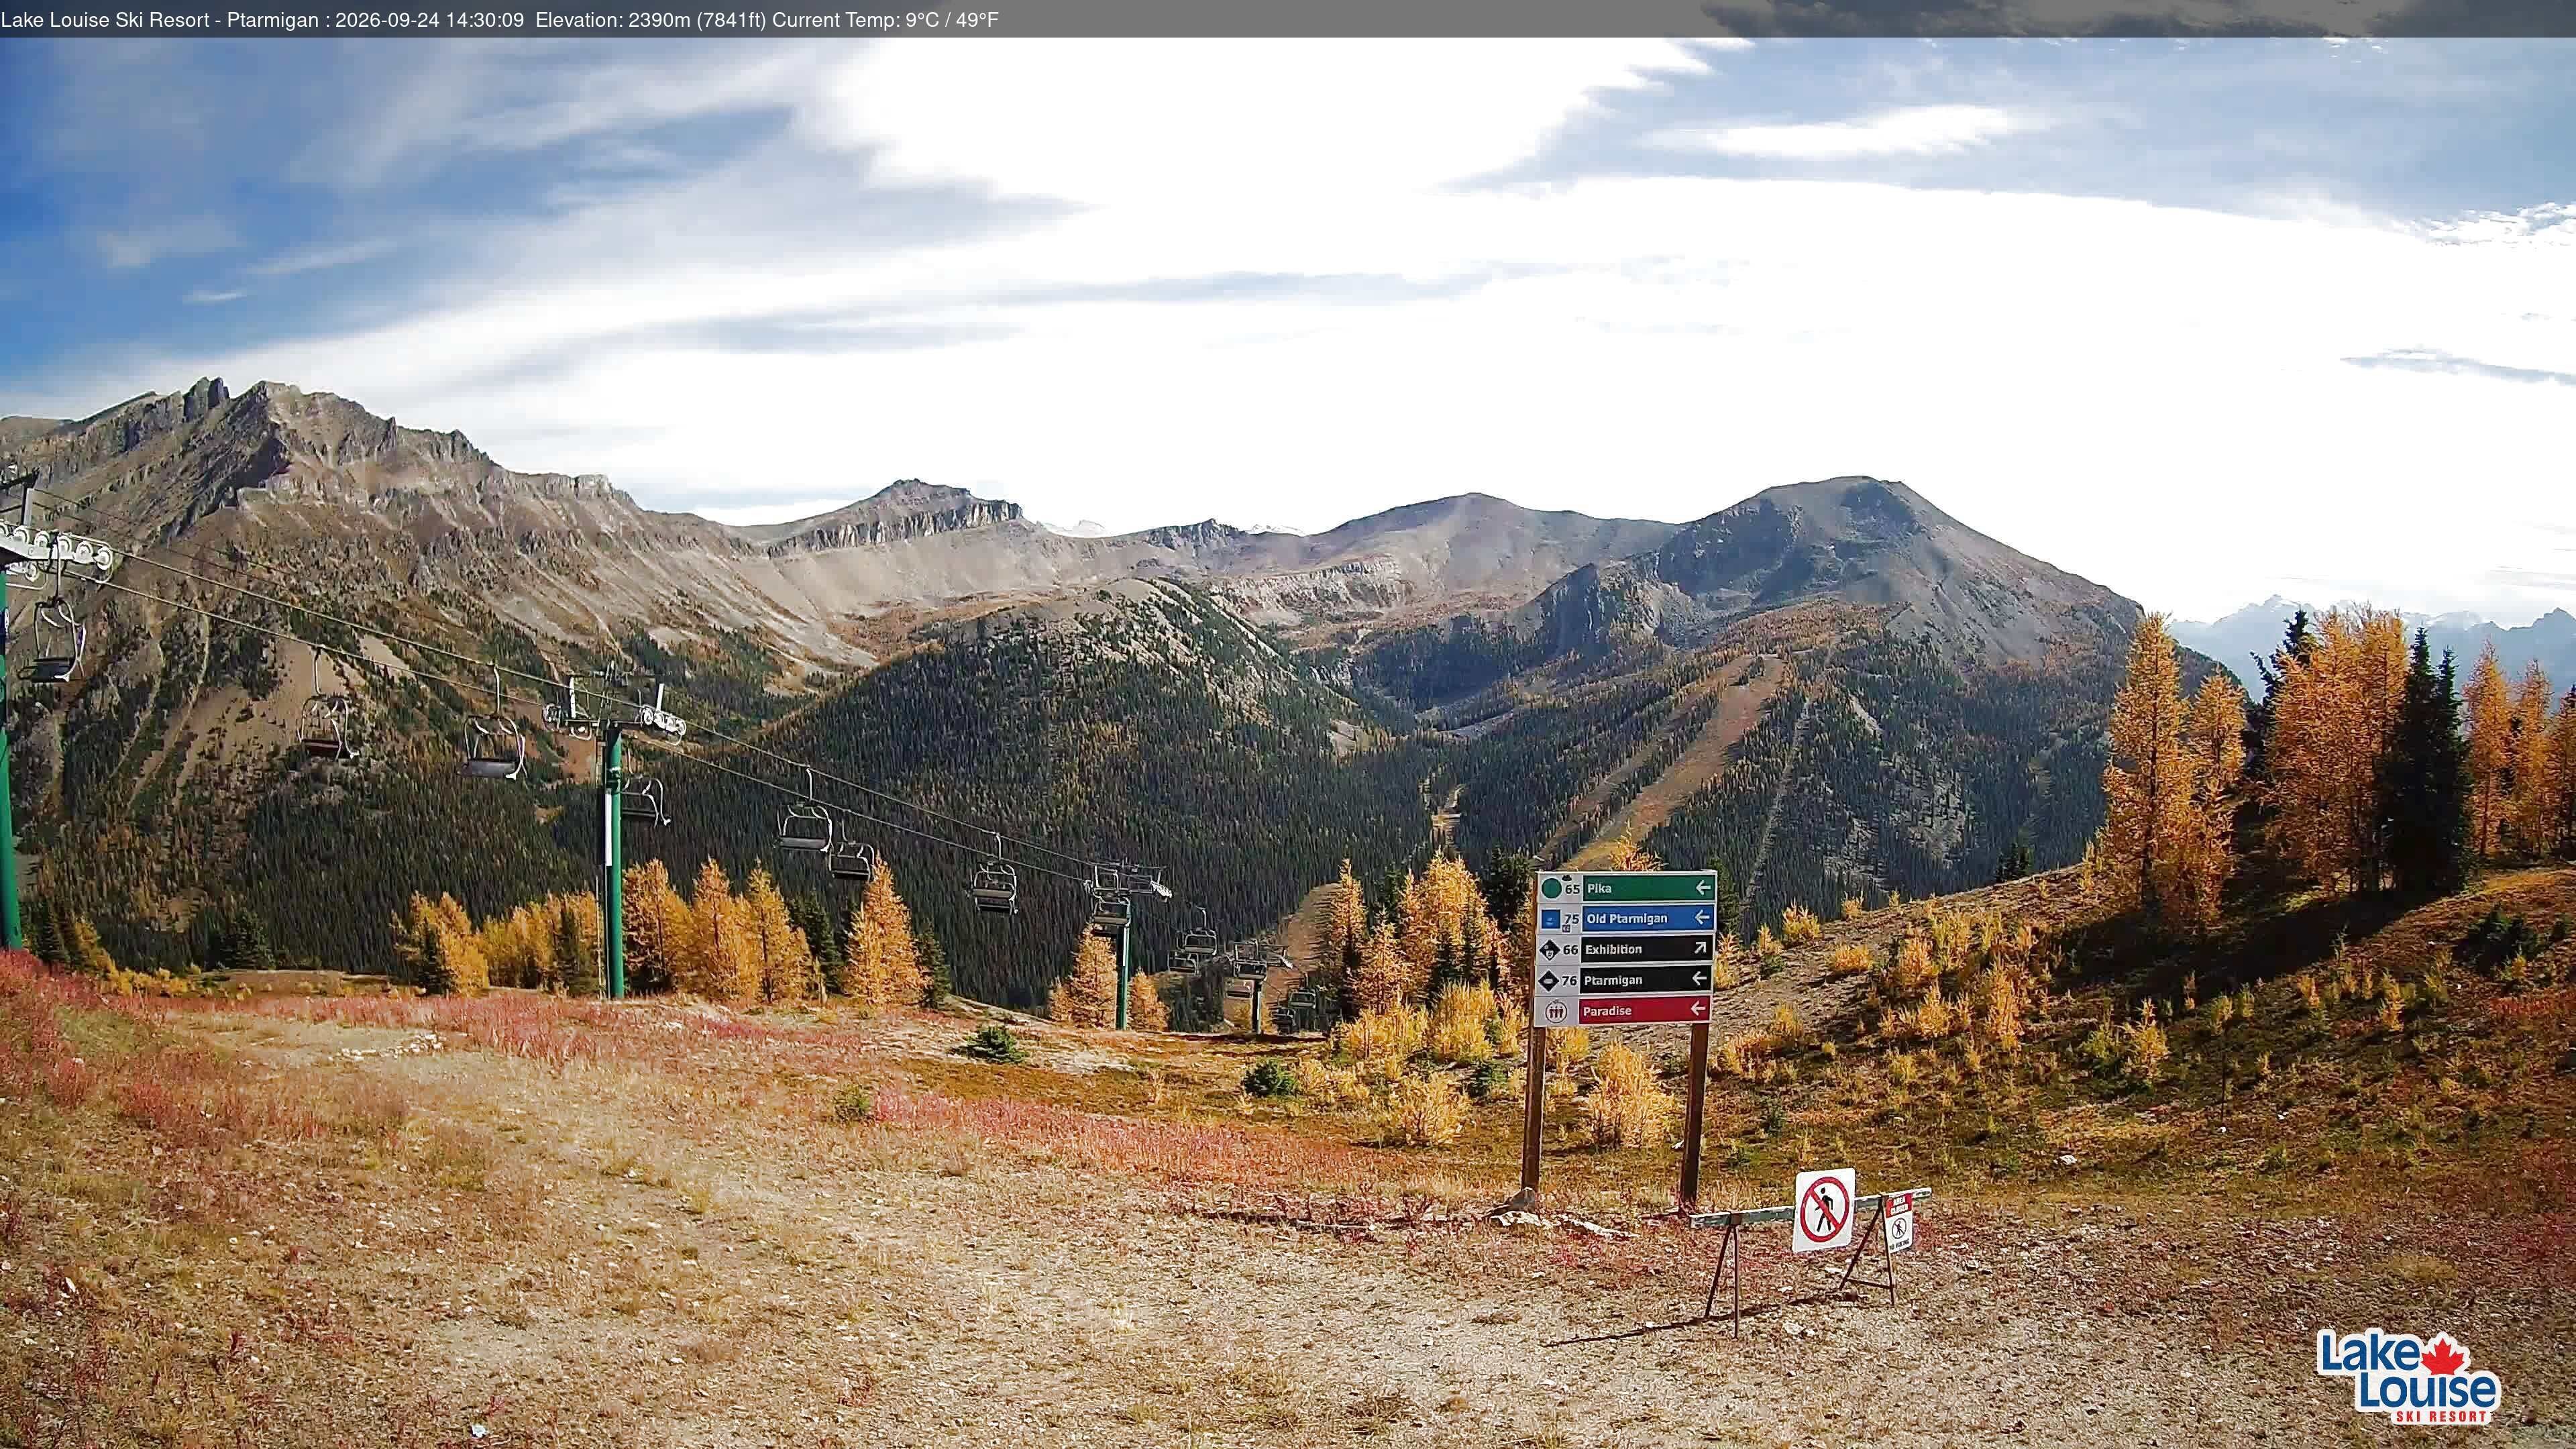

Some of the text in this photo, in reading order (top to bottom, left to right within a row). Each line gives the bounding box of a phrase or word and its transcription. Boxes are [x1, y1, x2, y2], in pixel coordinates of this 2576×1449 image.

[1565, 883, 1612, 894] 65 Pika
[1564, 913, 1668, 925] 75 Old Ptarmigan
[1563, 944, 1643, 955] 66 Exhibition
[1562, 975, 1643, 987] 76 Ptarmigan
[1583, 1006, 1632, 1017] Paradise
